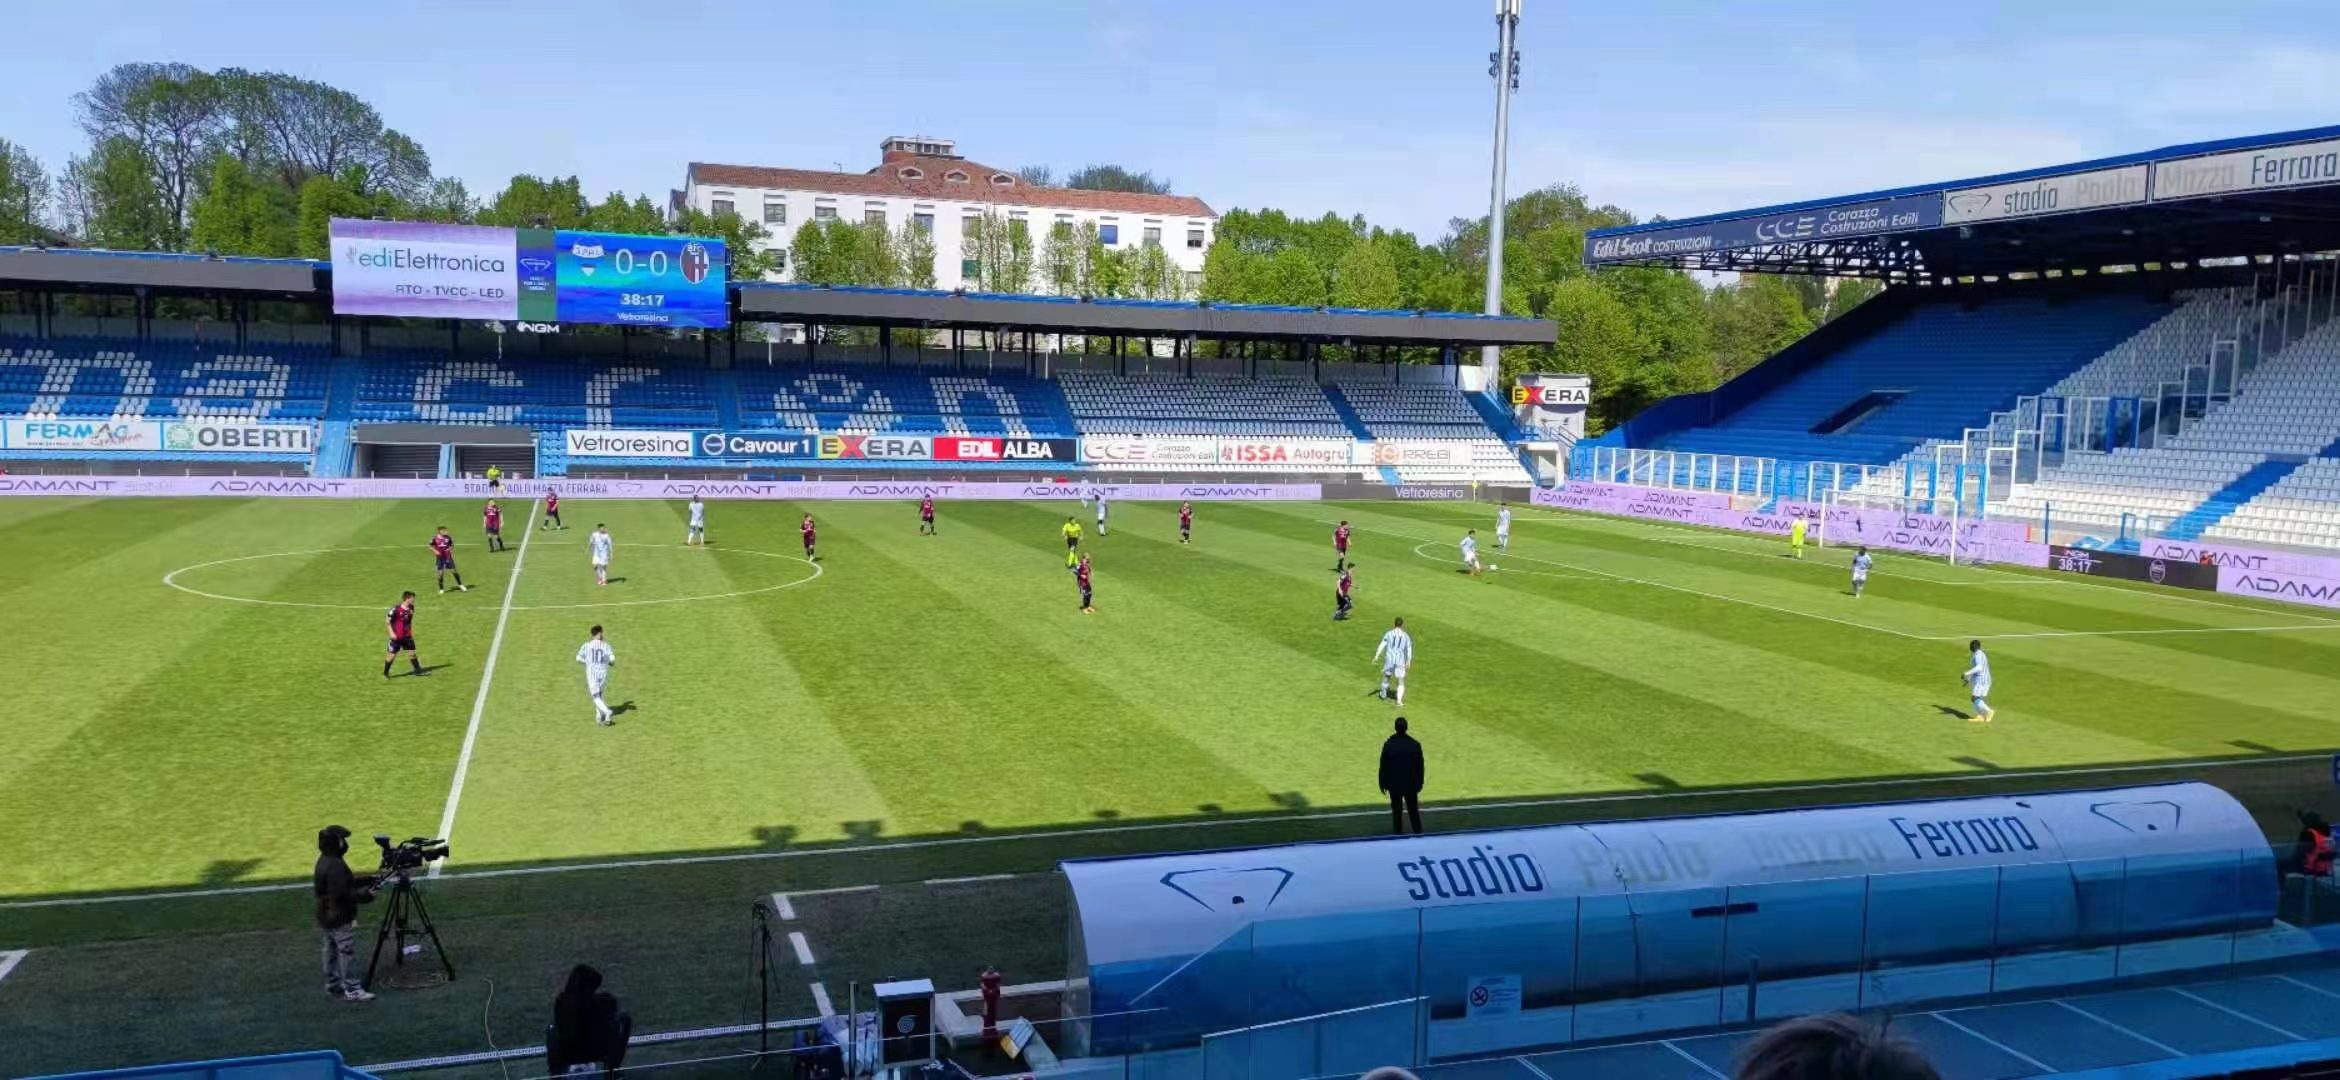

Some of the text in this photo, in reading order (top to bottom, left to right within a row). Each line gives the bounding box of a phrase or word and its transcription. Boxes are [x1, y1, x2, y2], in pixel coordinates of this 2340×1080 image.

[2003, 182, 2059, 215] stadio
[2251, 152, 2338, 186] Ferrara
[1820, 211, 1919, 234] Costruzioni Edili
[358, 246, 505, 273] ediElettronica
[480, 288, 504, 299] LED
[621, 293, 665, 307] 38:17
[527, 323, 560, 333] NGM
[1514, 387, 1587, 403] EXERA
[198, 427, 308, 448] OBERTI
[570, 432, 690, 452] Vetroresina
[729, 437, 810, 454] Cavour 1
[822, 436, 927, 459] EXERA
[957, 442, 1053, 458] EDIL ALBA
[1236, 445, 1287, 462] ISSA
[210, 481, 345, 492] ADAMANT
[663, 484, 777, 495] ADAMANT
[849, 486, 953, 496] ADAMANT
[1180, 488, 1273, 496] ADAMANT
[1395, 486, 1464, 499] Vetroresina
[1536, 492, 1590, 506] ADAMANT
[1627, 503, 1693, 519] ADAMANT
[2058, 559, 2092, 573] 38:17
[591, 648, 604, 663] 10
[1397, 845, 1544, 901] stadio
[1889, 815, 2039, 860] Ferrara
